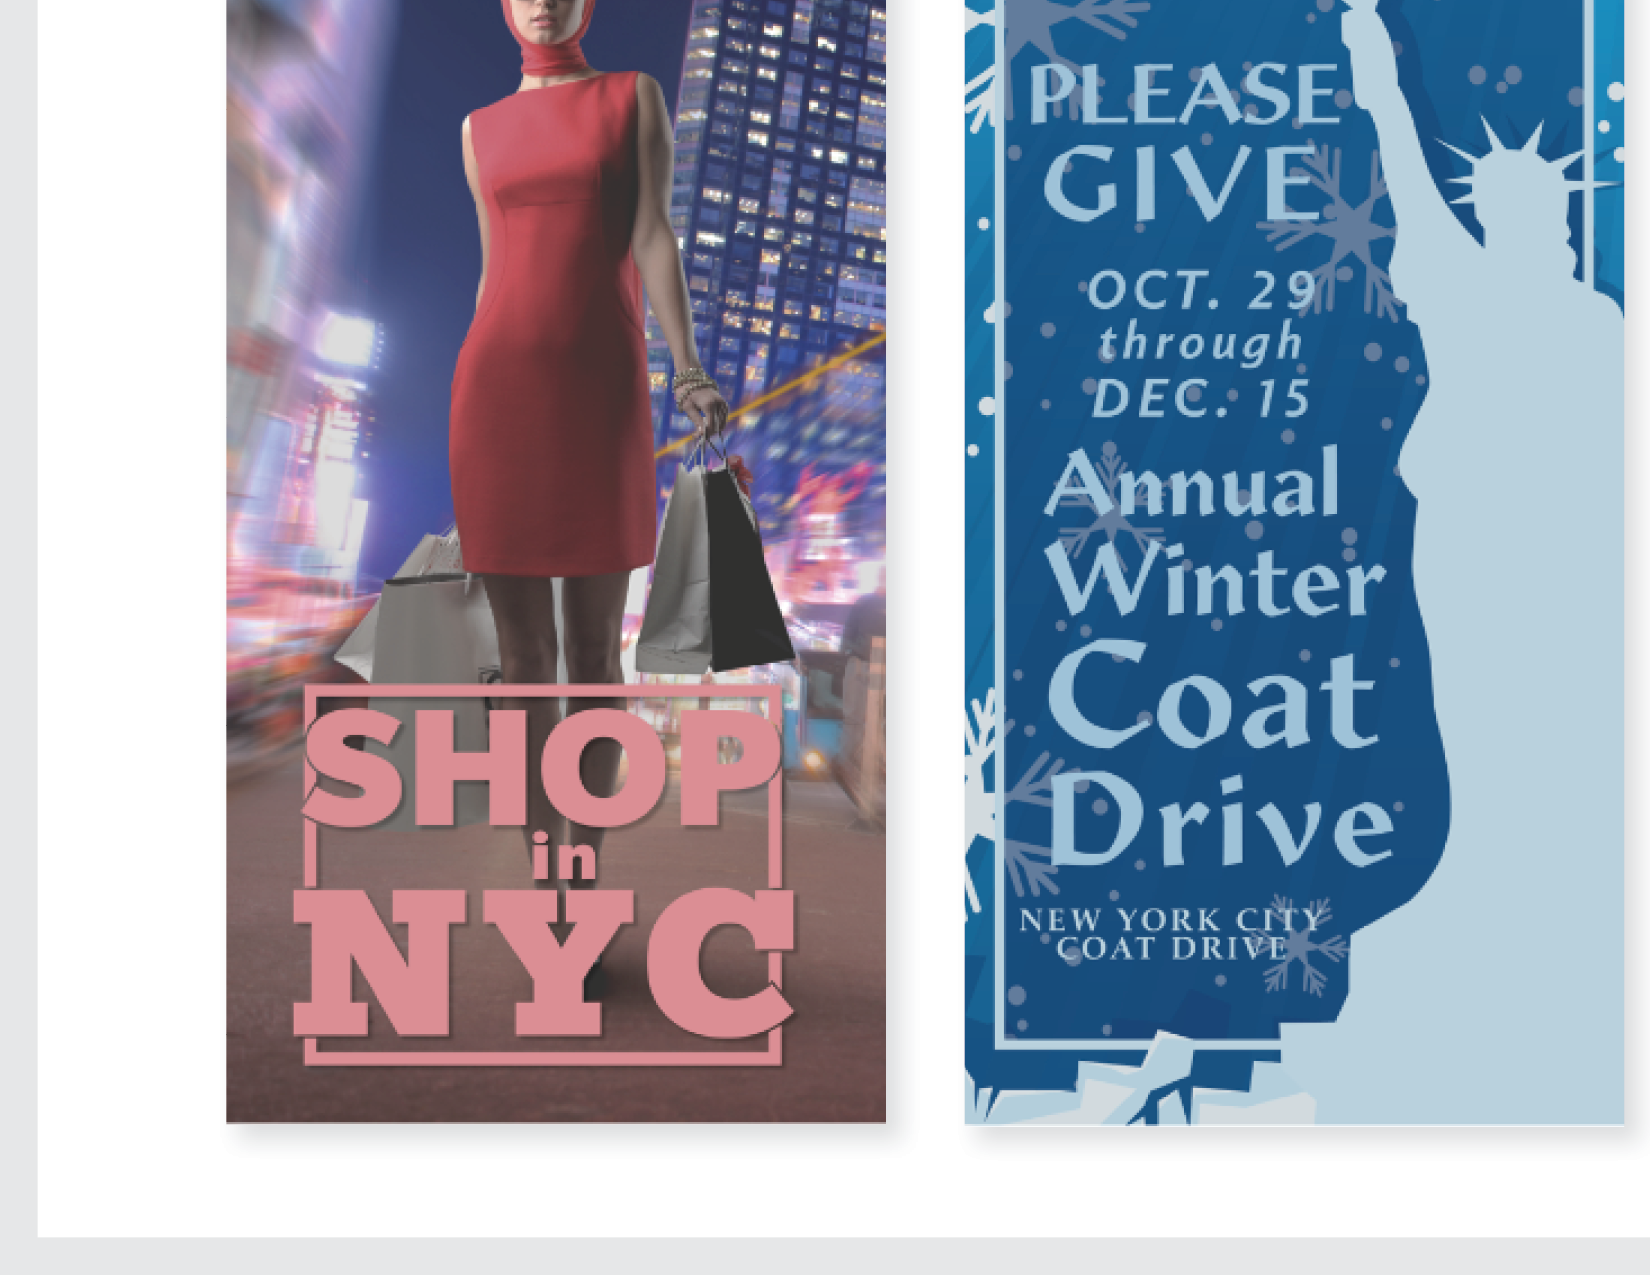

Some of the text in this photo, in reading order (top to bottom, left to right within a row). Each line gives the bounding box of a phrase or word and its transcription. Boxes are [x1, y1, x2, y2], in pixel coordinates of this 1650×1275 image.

[1030, 62, 1341, 124] PLEASE
[1043, 144, 1320, 222] GIVE
[1087, 270, 1316, 311] OCT. 29
[1100, 318, 1301, 368] through
[1092, 379, 1311, 418] DEC. 15
[1043, 443, 1338, 517] Annual
[1043, 539, 1388, 617] Winter
[1048, 639, 1379, 749] Coat
[301, 708, 782, 828] SHOP
[1050, 770, 1394, 868] Drive
[532, 830, 595, 879] in
[1019, 907, 1324, 932] NEW YORK CITY
[1056, 936, 1288, 961] COAT DRIVE
[293, 887, 794, 1038] NYC
